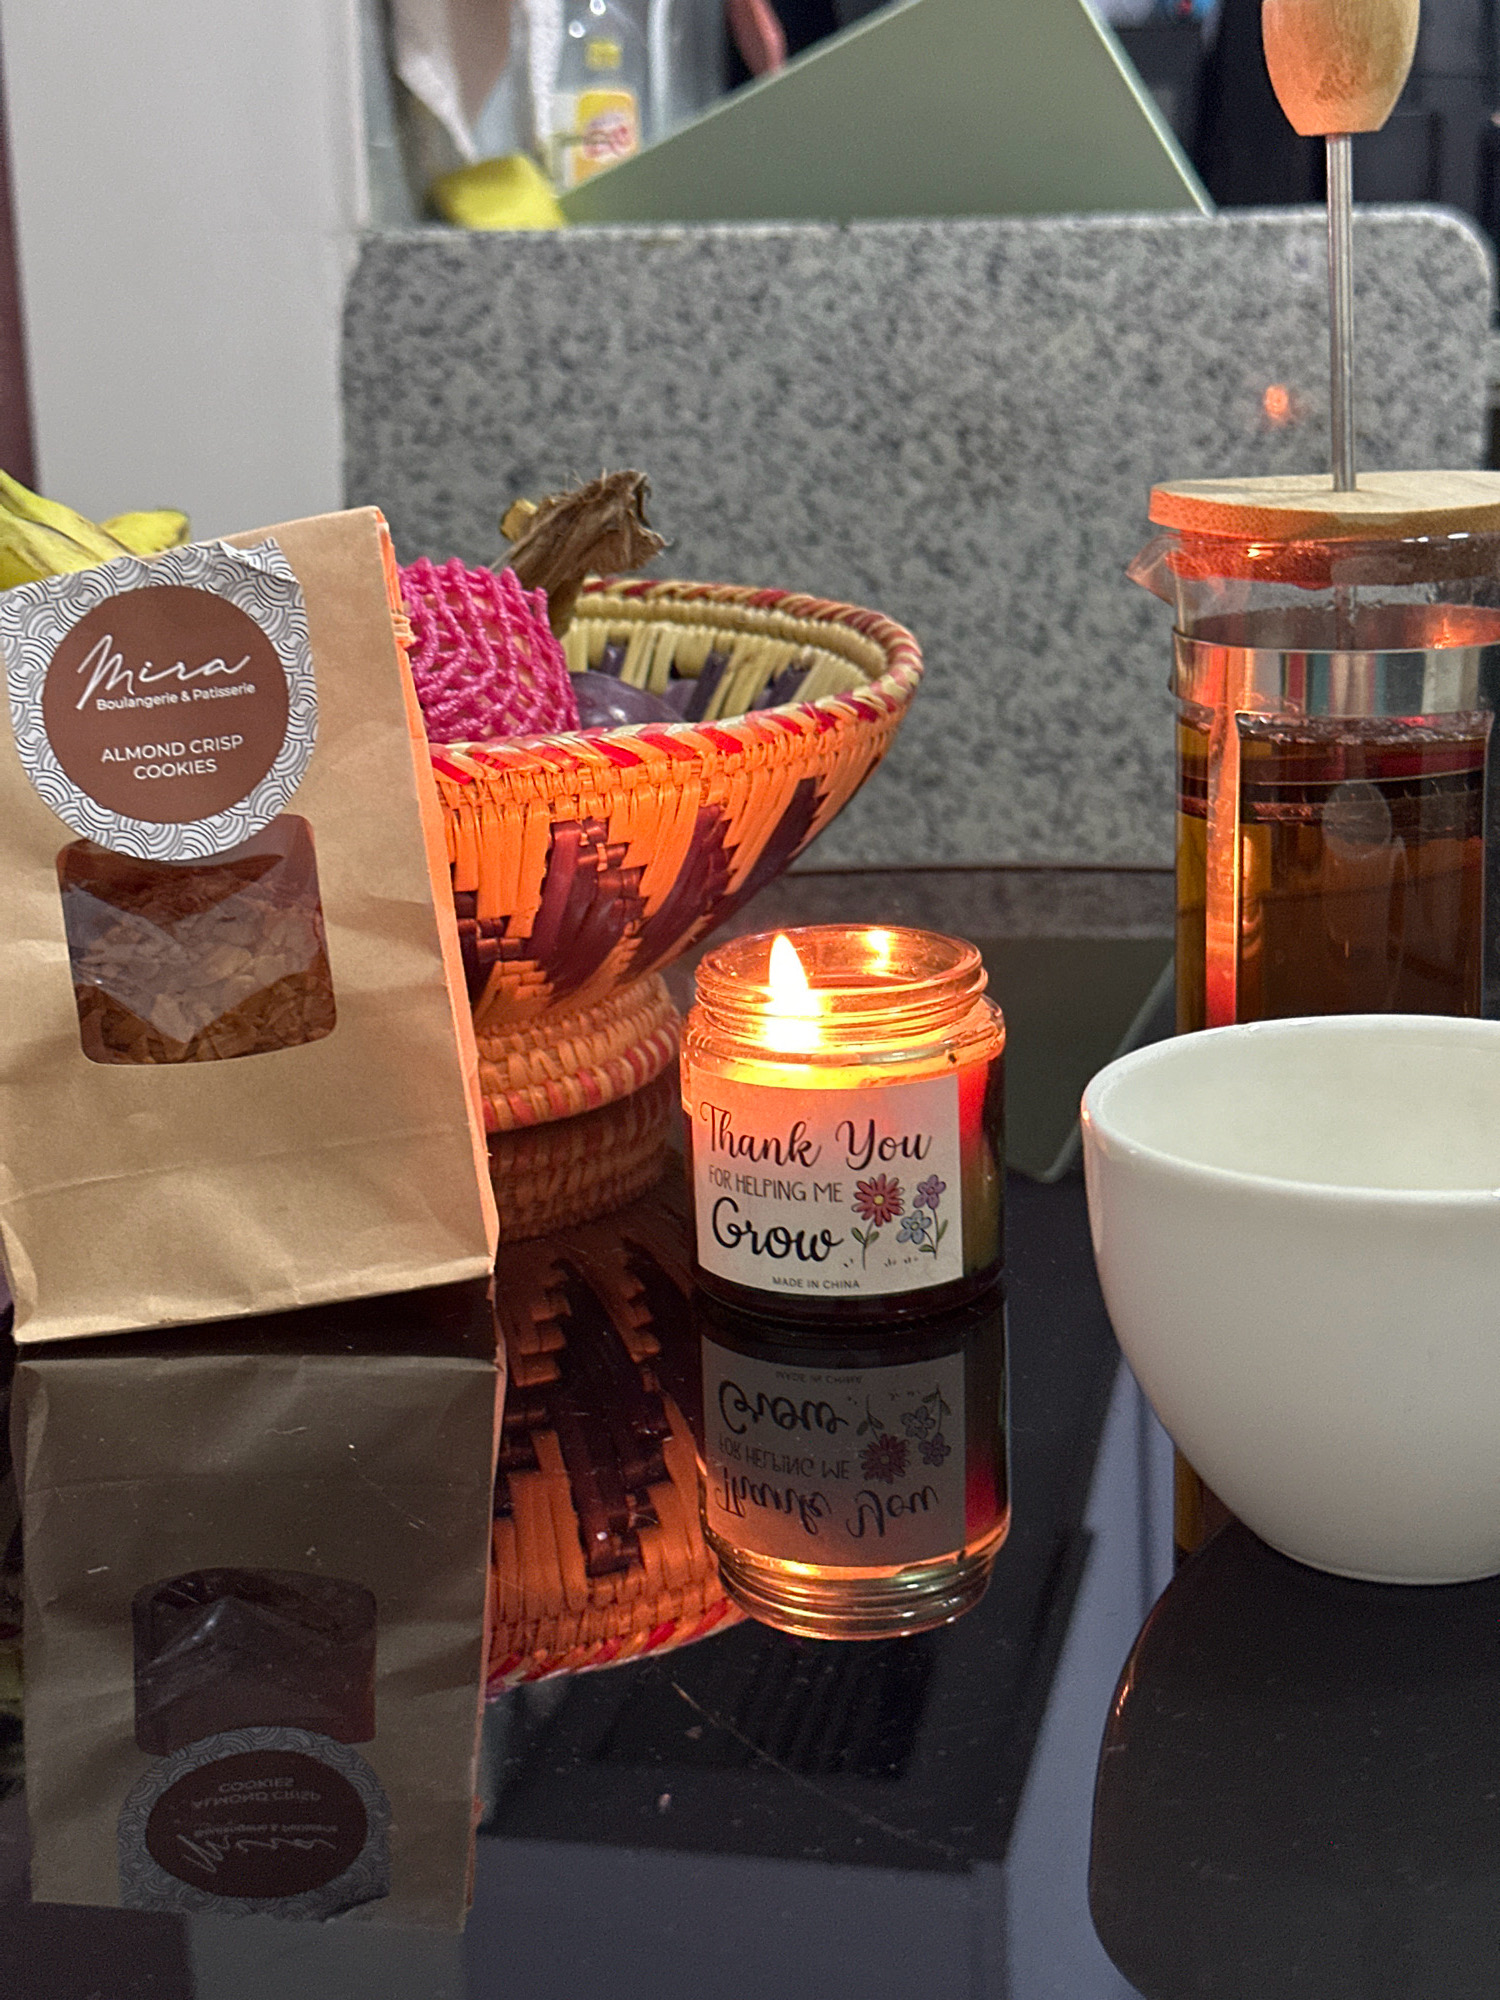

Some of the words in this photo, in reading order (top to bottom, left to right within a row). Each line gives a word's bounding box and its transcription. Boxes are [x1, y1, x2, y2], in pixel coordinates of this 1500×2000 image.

[76, 634, 251, 710] Mira
[96, 691, 178, 711] Boulangerie
[180, 690, 191, 702] &
[193, 682, 256, 701] Patisserie
[101, 742, 186, 763] ALMOND
[189, 734, 244, 754] CRISP
[133, 758, 219, 780] COOKIES
[700, 1101, 822, 1167] Thank
[835, 1119, 932, 1171] You
[709, 1164, 733, 1190] FOR
[736, 1175, 806, 1201] HELPING
[813, 1182, 843, 1203] ME
[712, 1196, 844, 1262] Grow
[772, 1276, 802, 1288] MADE
[806, 1280, 820, 1289] IN
[823, 1280, 860, 1289] CHINA
